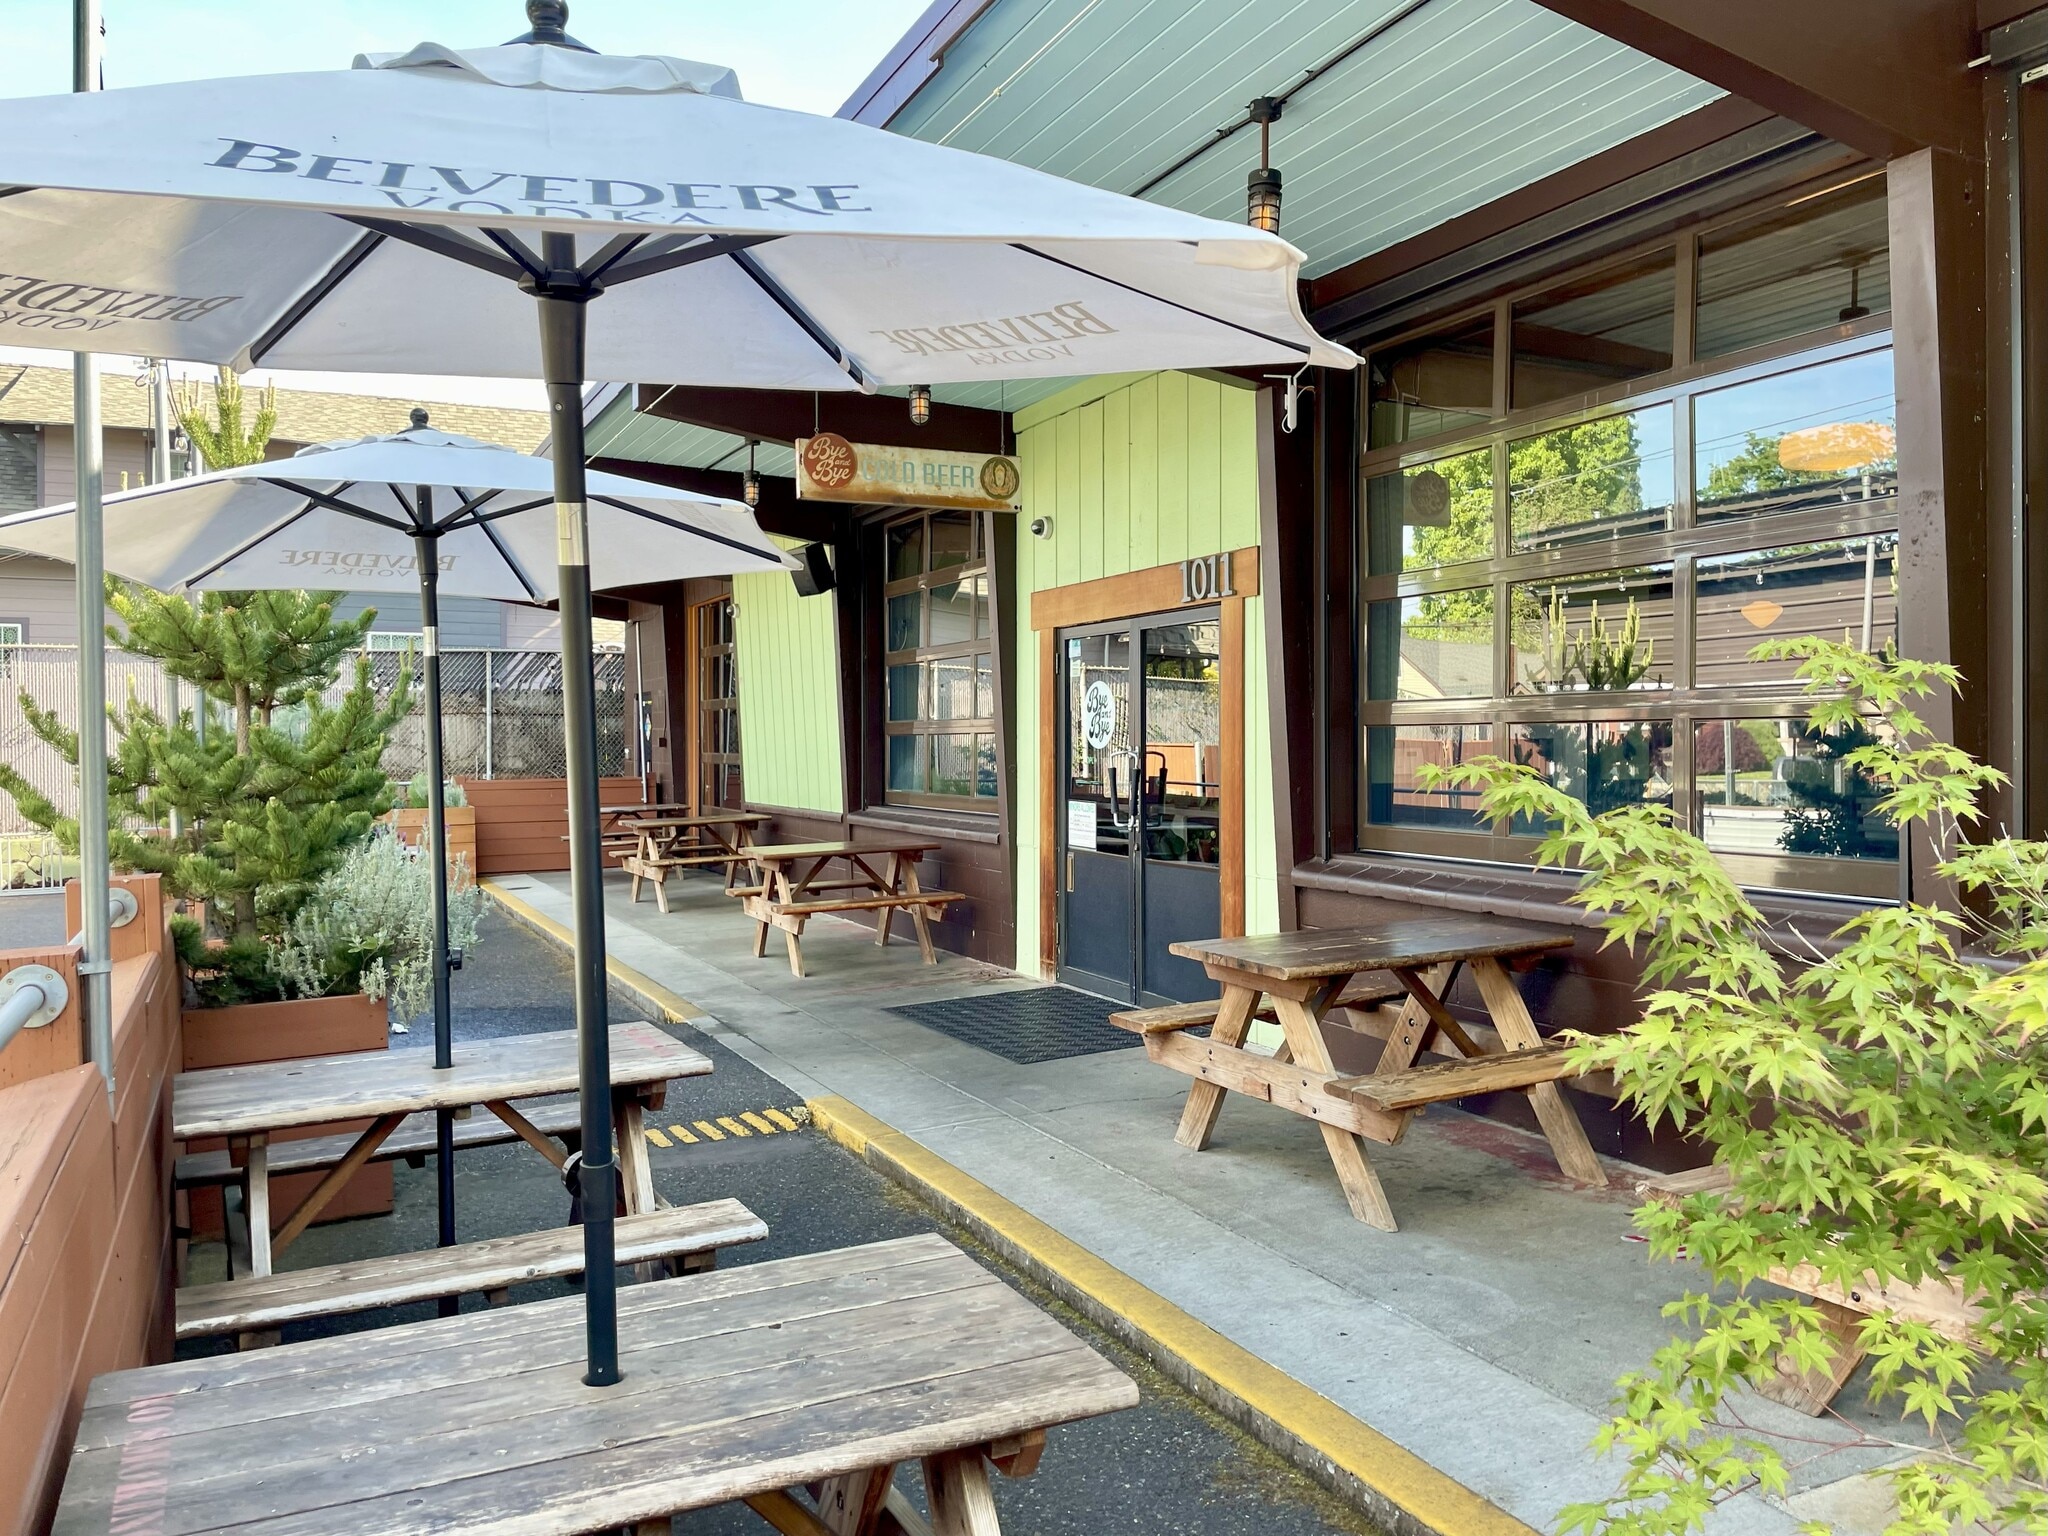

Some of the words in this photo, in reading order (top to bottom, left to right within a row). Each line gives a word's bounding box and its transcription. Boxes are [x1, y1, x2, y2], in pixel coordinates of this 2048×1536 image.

[203, 137, 872, 216] BELVEDERE
[807, 436, 849, 462] Bye
[811, 459, 852, 486] Bye
[862, 457, 916, 485] COLD
[922, 462, 975, 489] BEER
[1179, 552, 1237, 603] 1011
[1087, 686, 1108, 716] Bye
[1088, 714, 1110, 743] Bye
